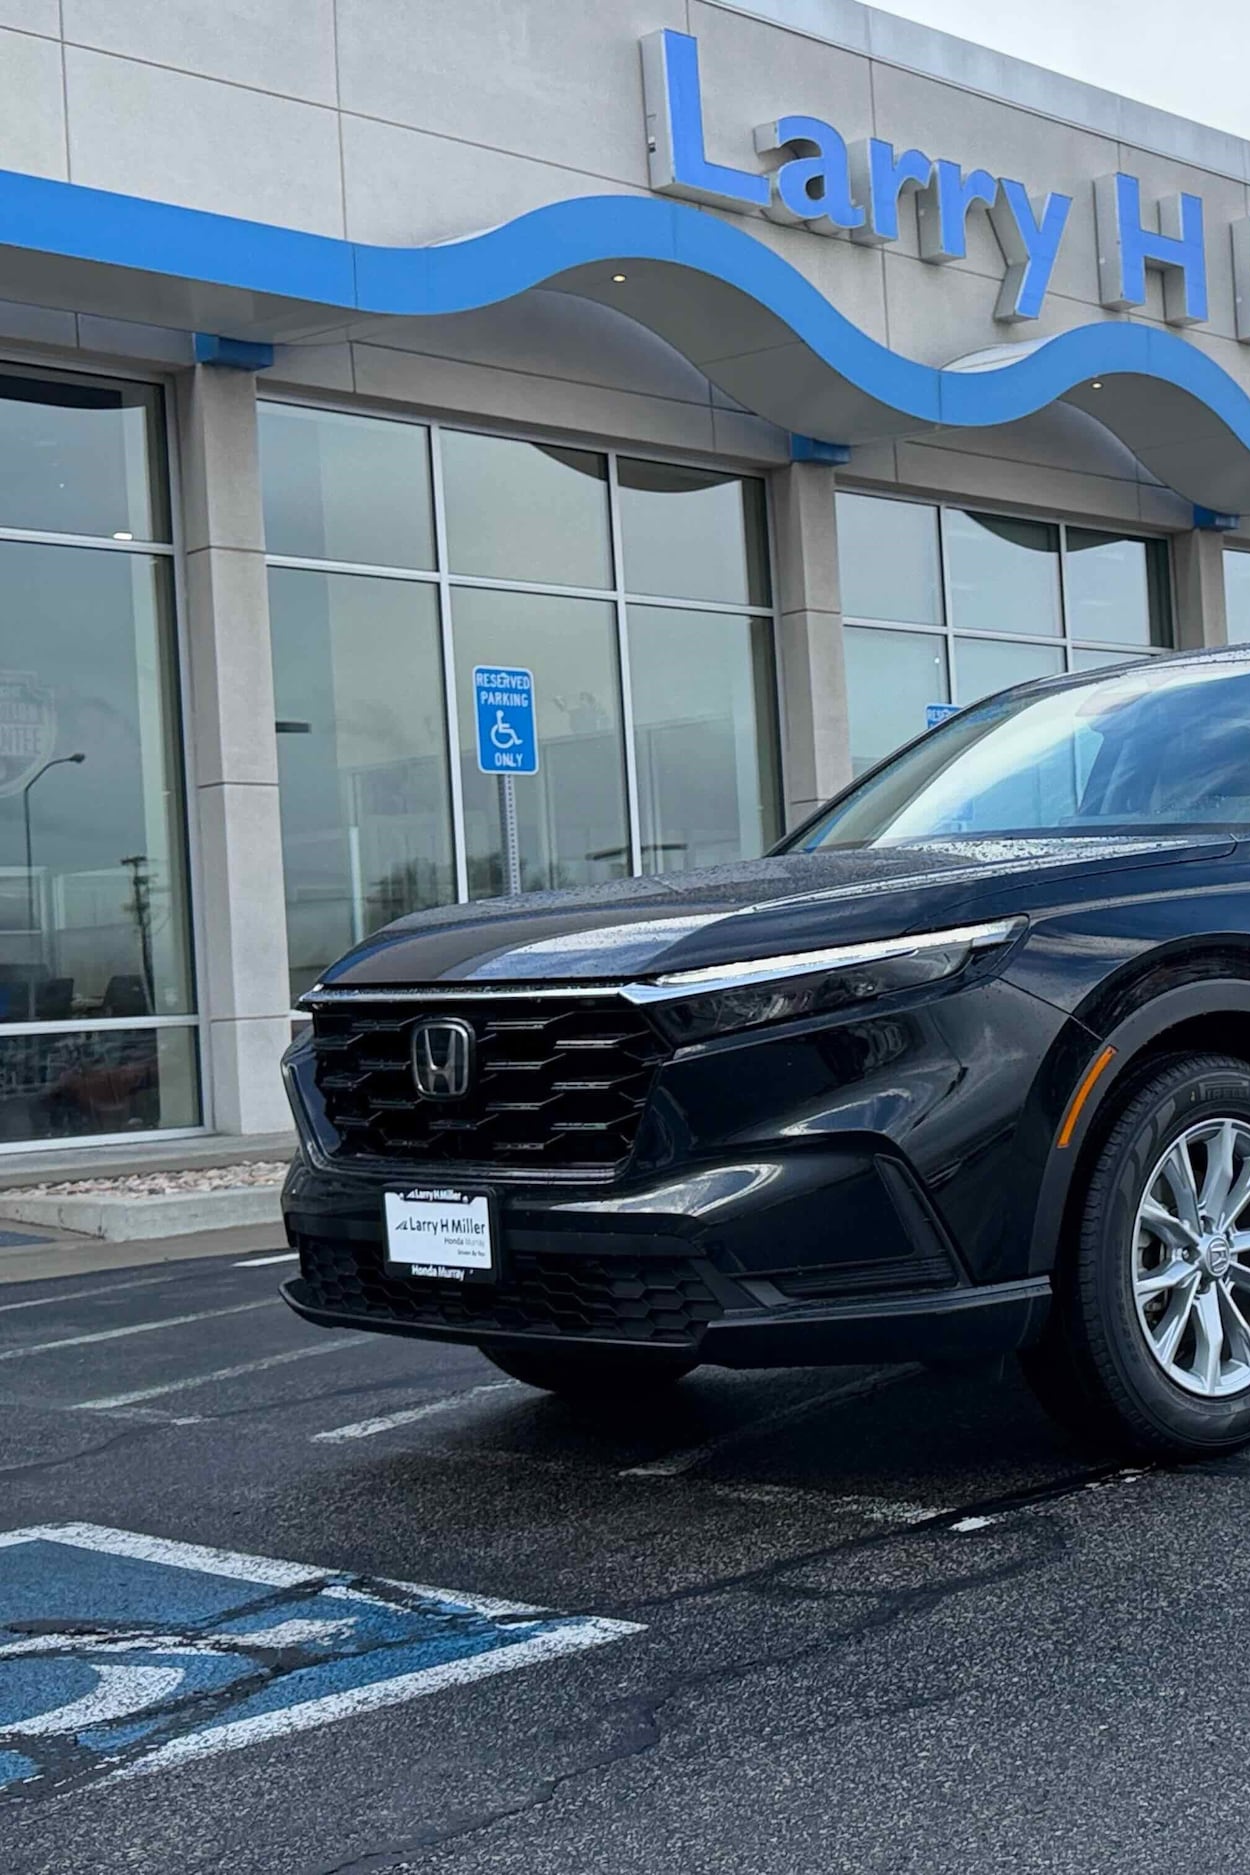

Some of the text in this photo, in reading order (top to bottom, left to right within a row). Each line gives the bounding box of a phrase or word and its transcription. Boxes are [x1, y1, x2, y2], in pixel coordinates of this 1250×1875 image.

[650, 29, 1073, 323] Larry
[1102, 172, 1208, 325] H
[476, 672, 530, 690] RESERVED
[480, 691, 529, 707] PARKING
[495, 752, 523, 767] ONLY
[409, 1217, 486, 1235] Larry H Miller
